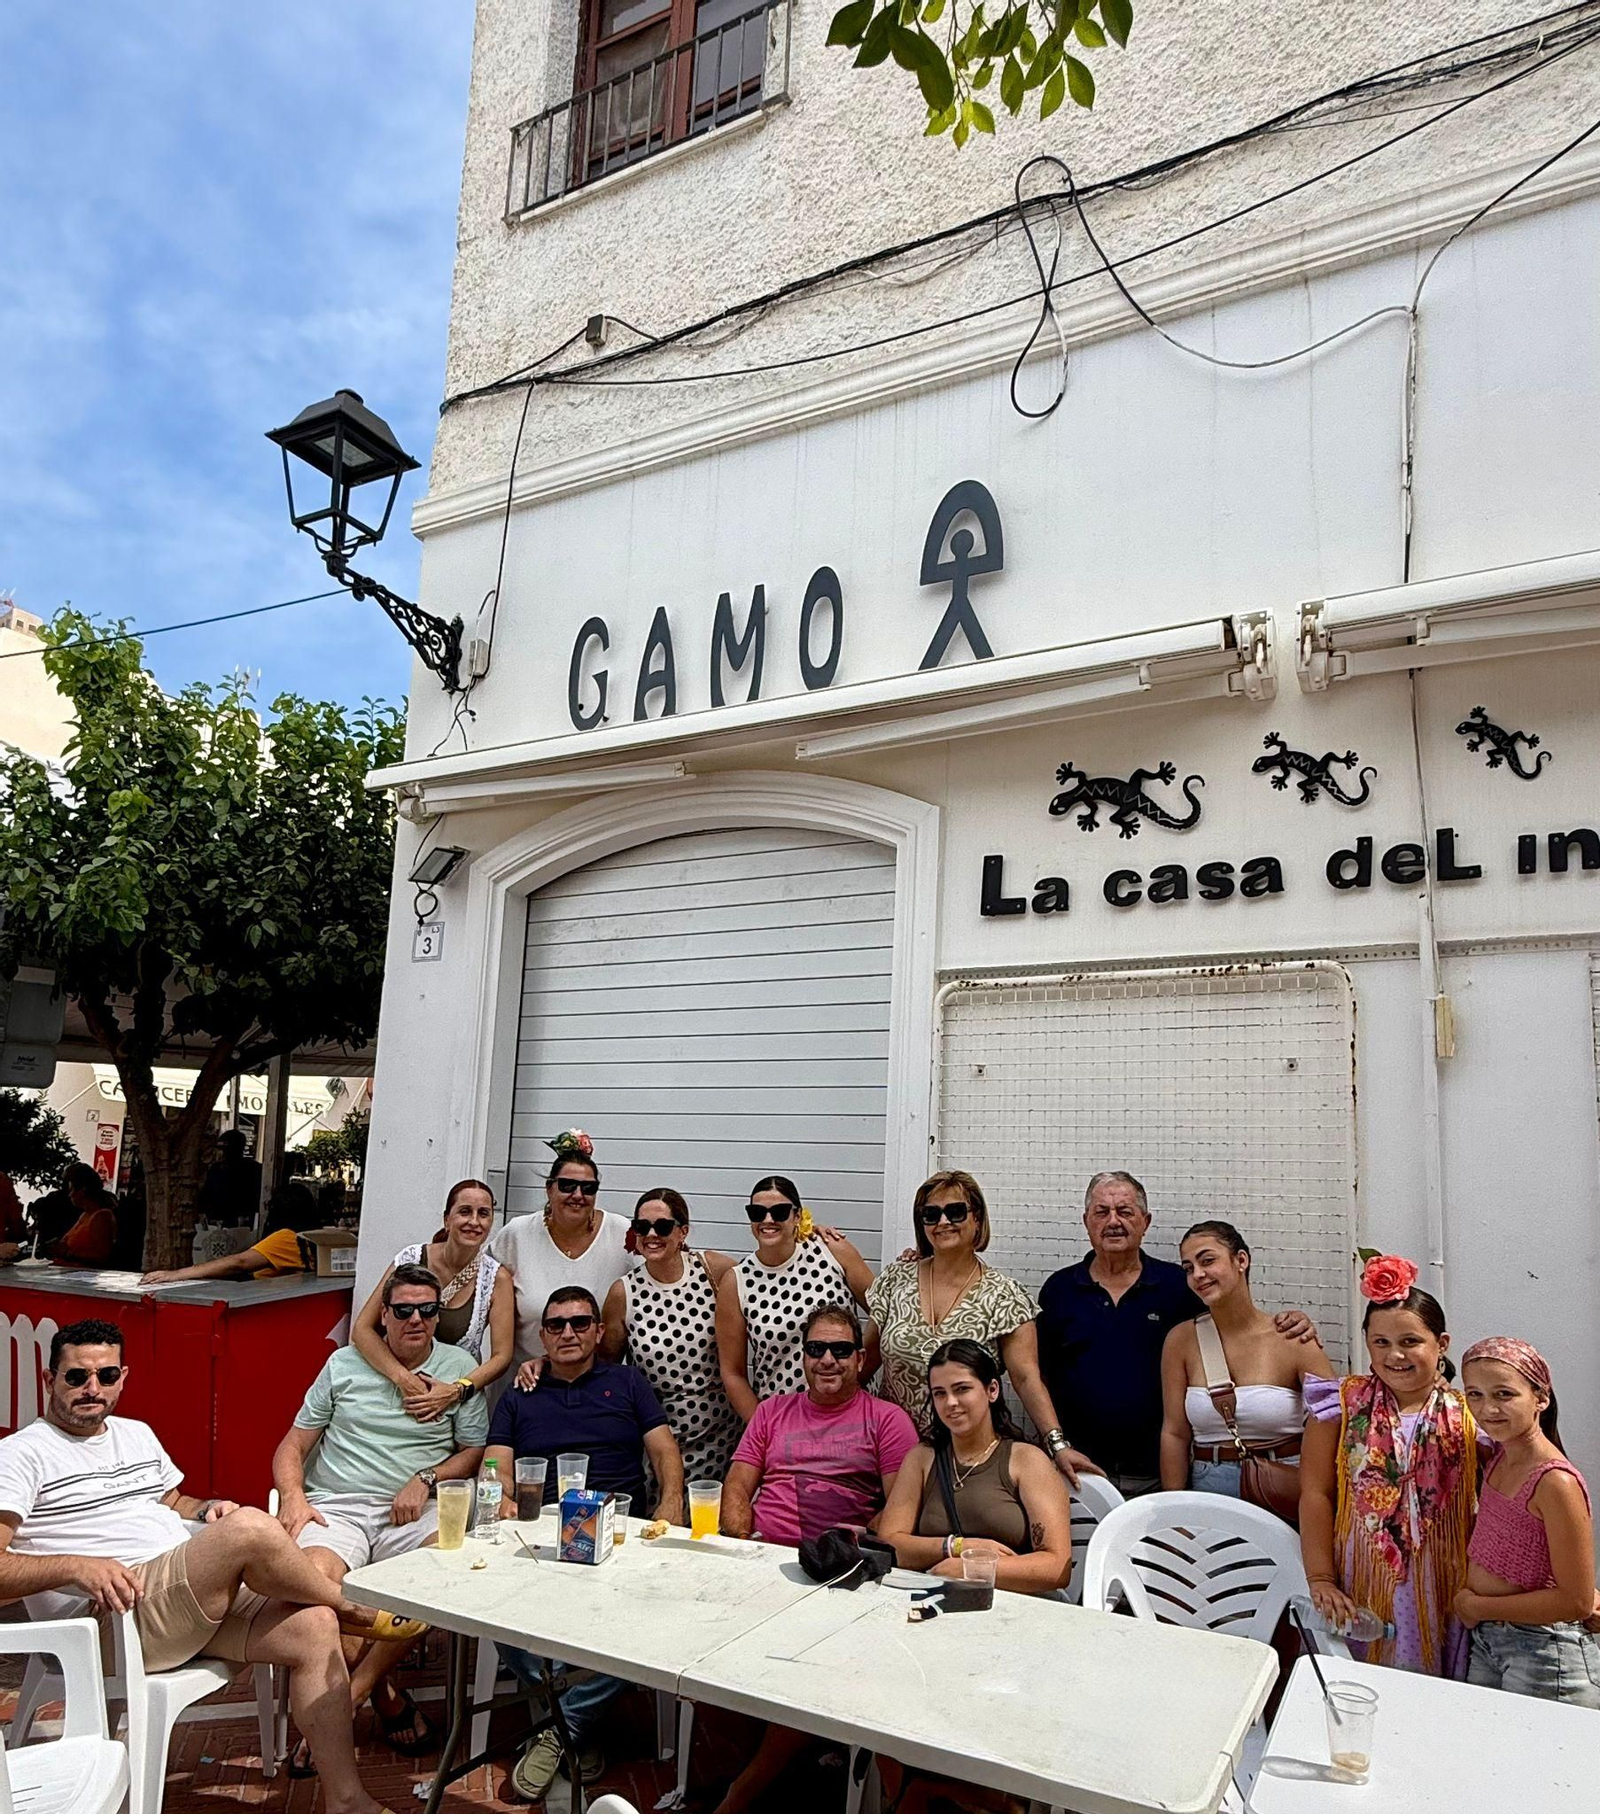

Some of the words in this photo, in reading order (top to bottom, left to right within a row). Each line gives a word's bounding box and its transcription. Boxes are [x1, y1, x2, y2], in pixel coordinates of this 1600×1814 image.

[568, 566, 843, 731] GAMO
[980, 854, 1069, 917] La
[1102, 856, 1285, 908] casa
[422, 936, 432, 954] 3
